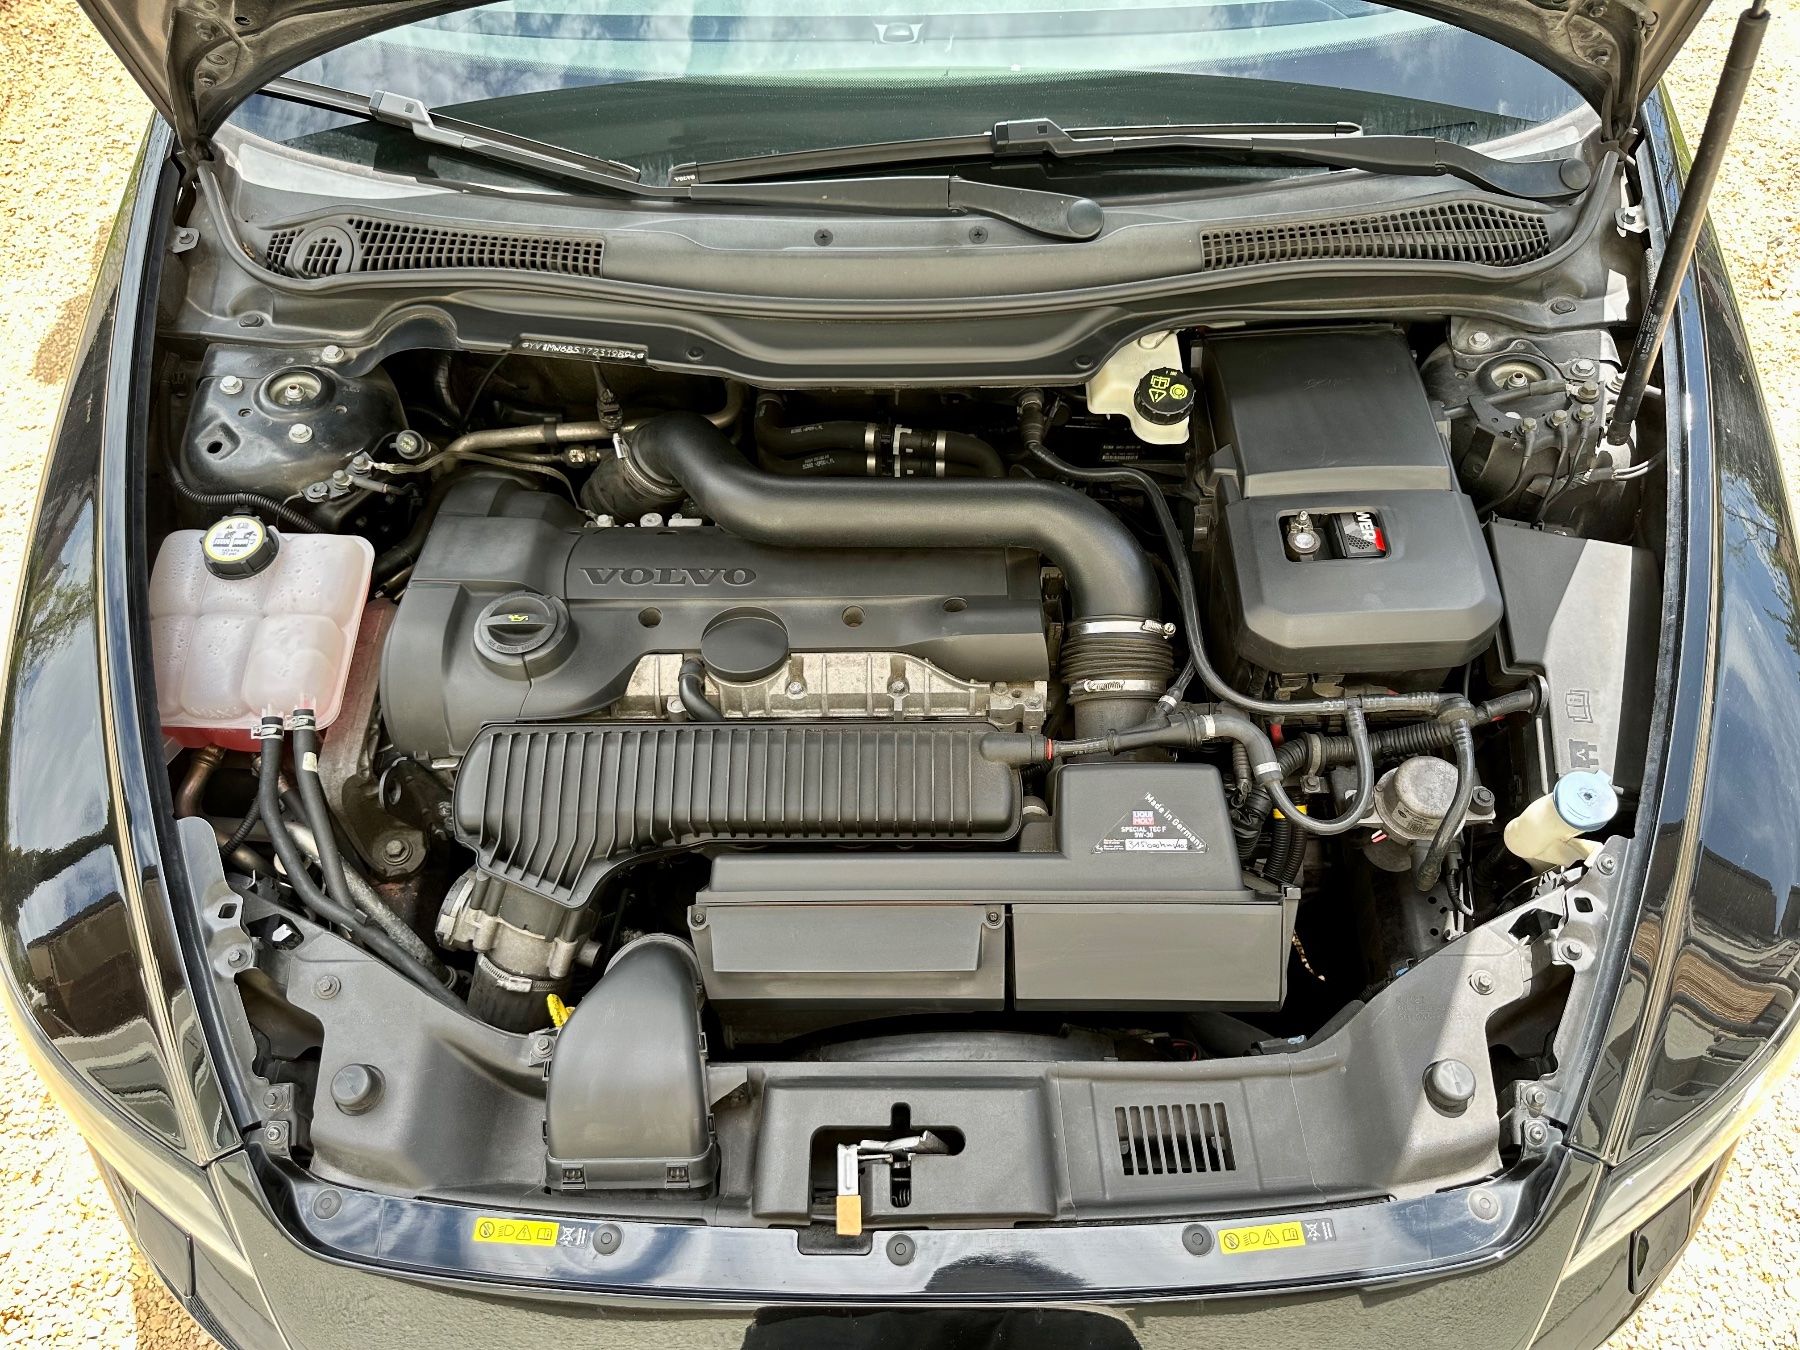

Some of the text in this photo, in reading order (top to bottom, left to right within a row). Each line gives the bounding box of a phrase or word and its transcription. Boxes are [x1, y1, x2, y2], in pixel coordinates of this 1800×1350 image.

[673, 174, 696, 182] VOLVO
[579, 567, 757, 587] VOLVO
[1145, 792, 1165, 814] Made
[1164, 810, 1174, 821] in
[1172, 818, 1205, 850] Germany
